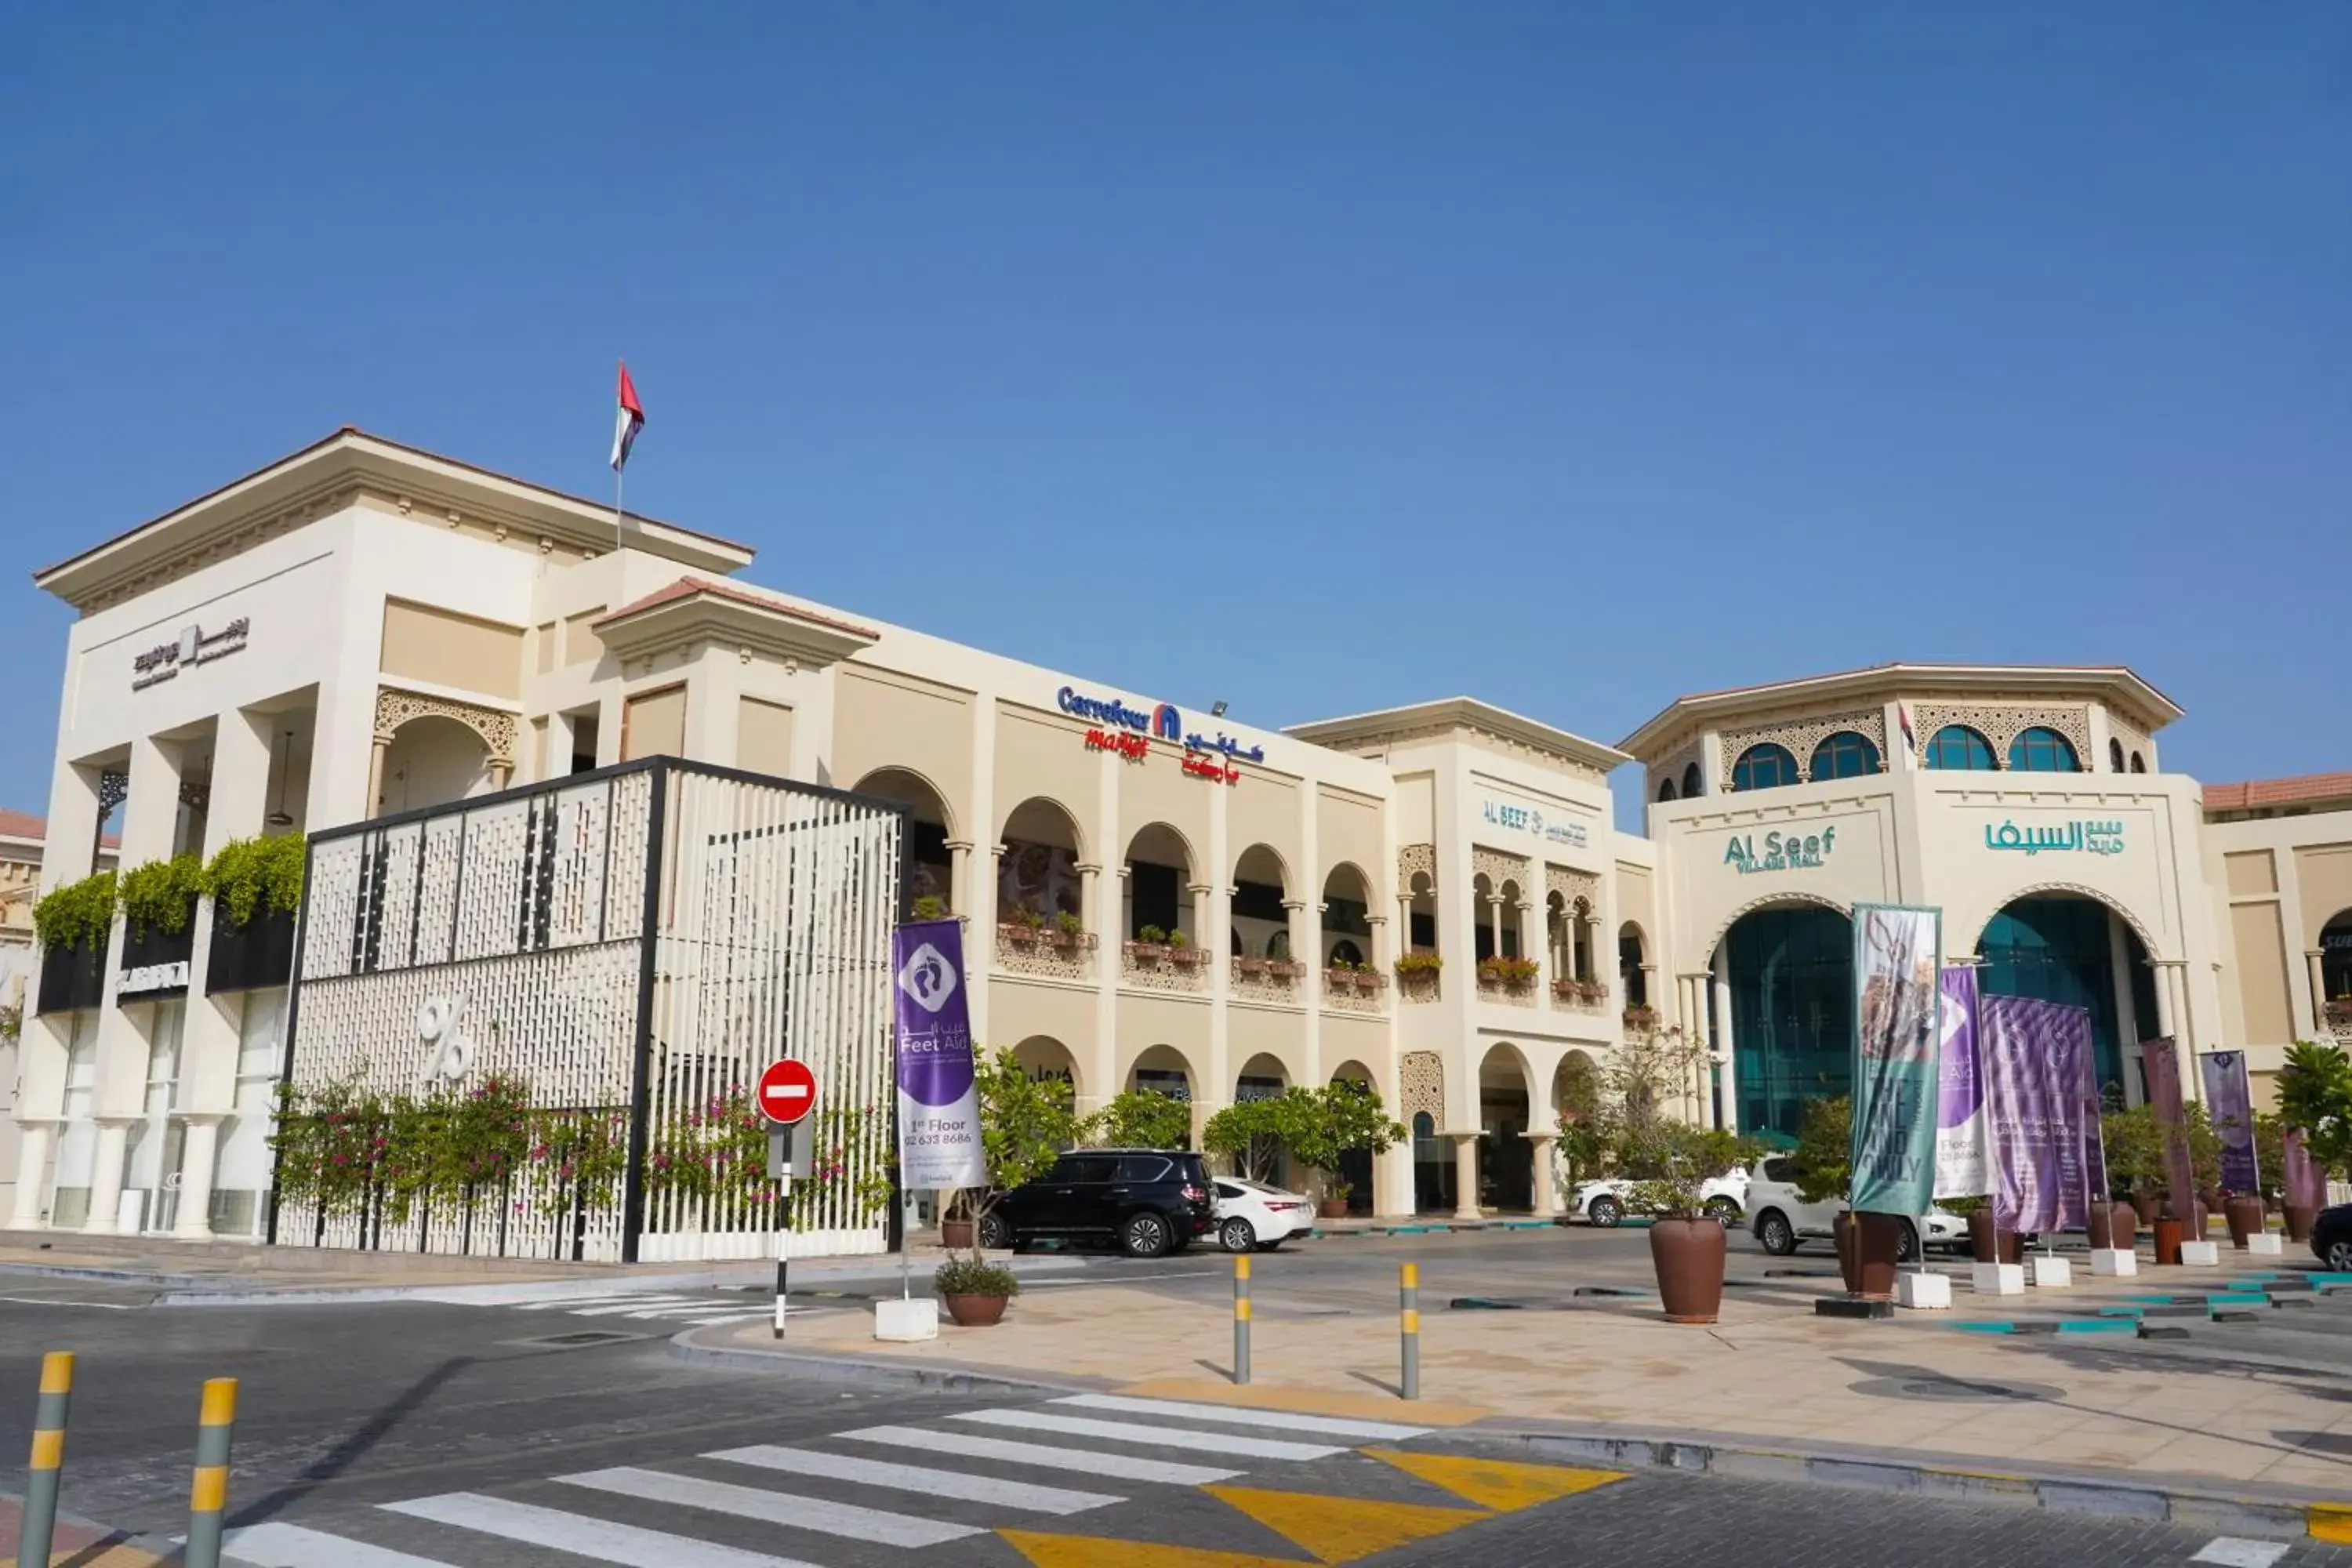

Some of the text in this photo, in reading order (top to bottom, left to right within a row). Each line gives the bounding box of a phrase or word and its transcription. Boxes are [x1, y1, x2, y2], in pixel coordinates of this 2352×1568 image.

[1058, 686, 1150, 731] Carrefour
[1084, 728, 1149, 759] market
[1724, 825, 1835, 864] Al Seef
[1985, 819, 2083, 856] السيف
[900, 1035, 968, 1054] Feet Aid
[928, 1119, 966, 1132] Floor
